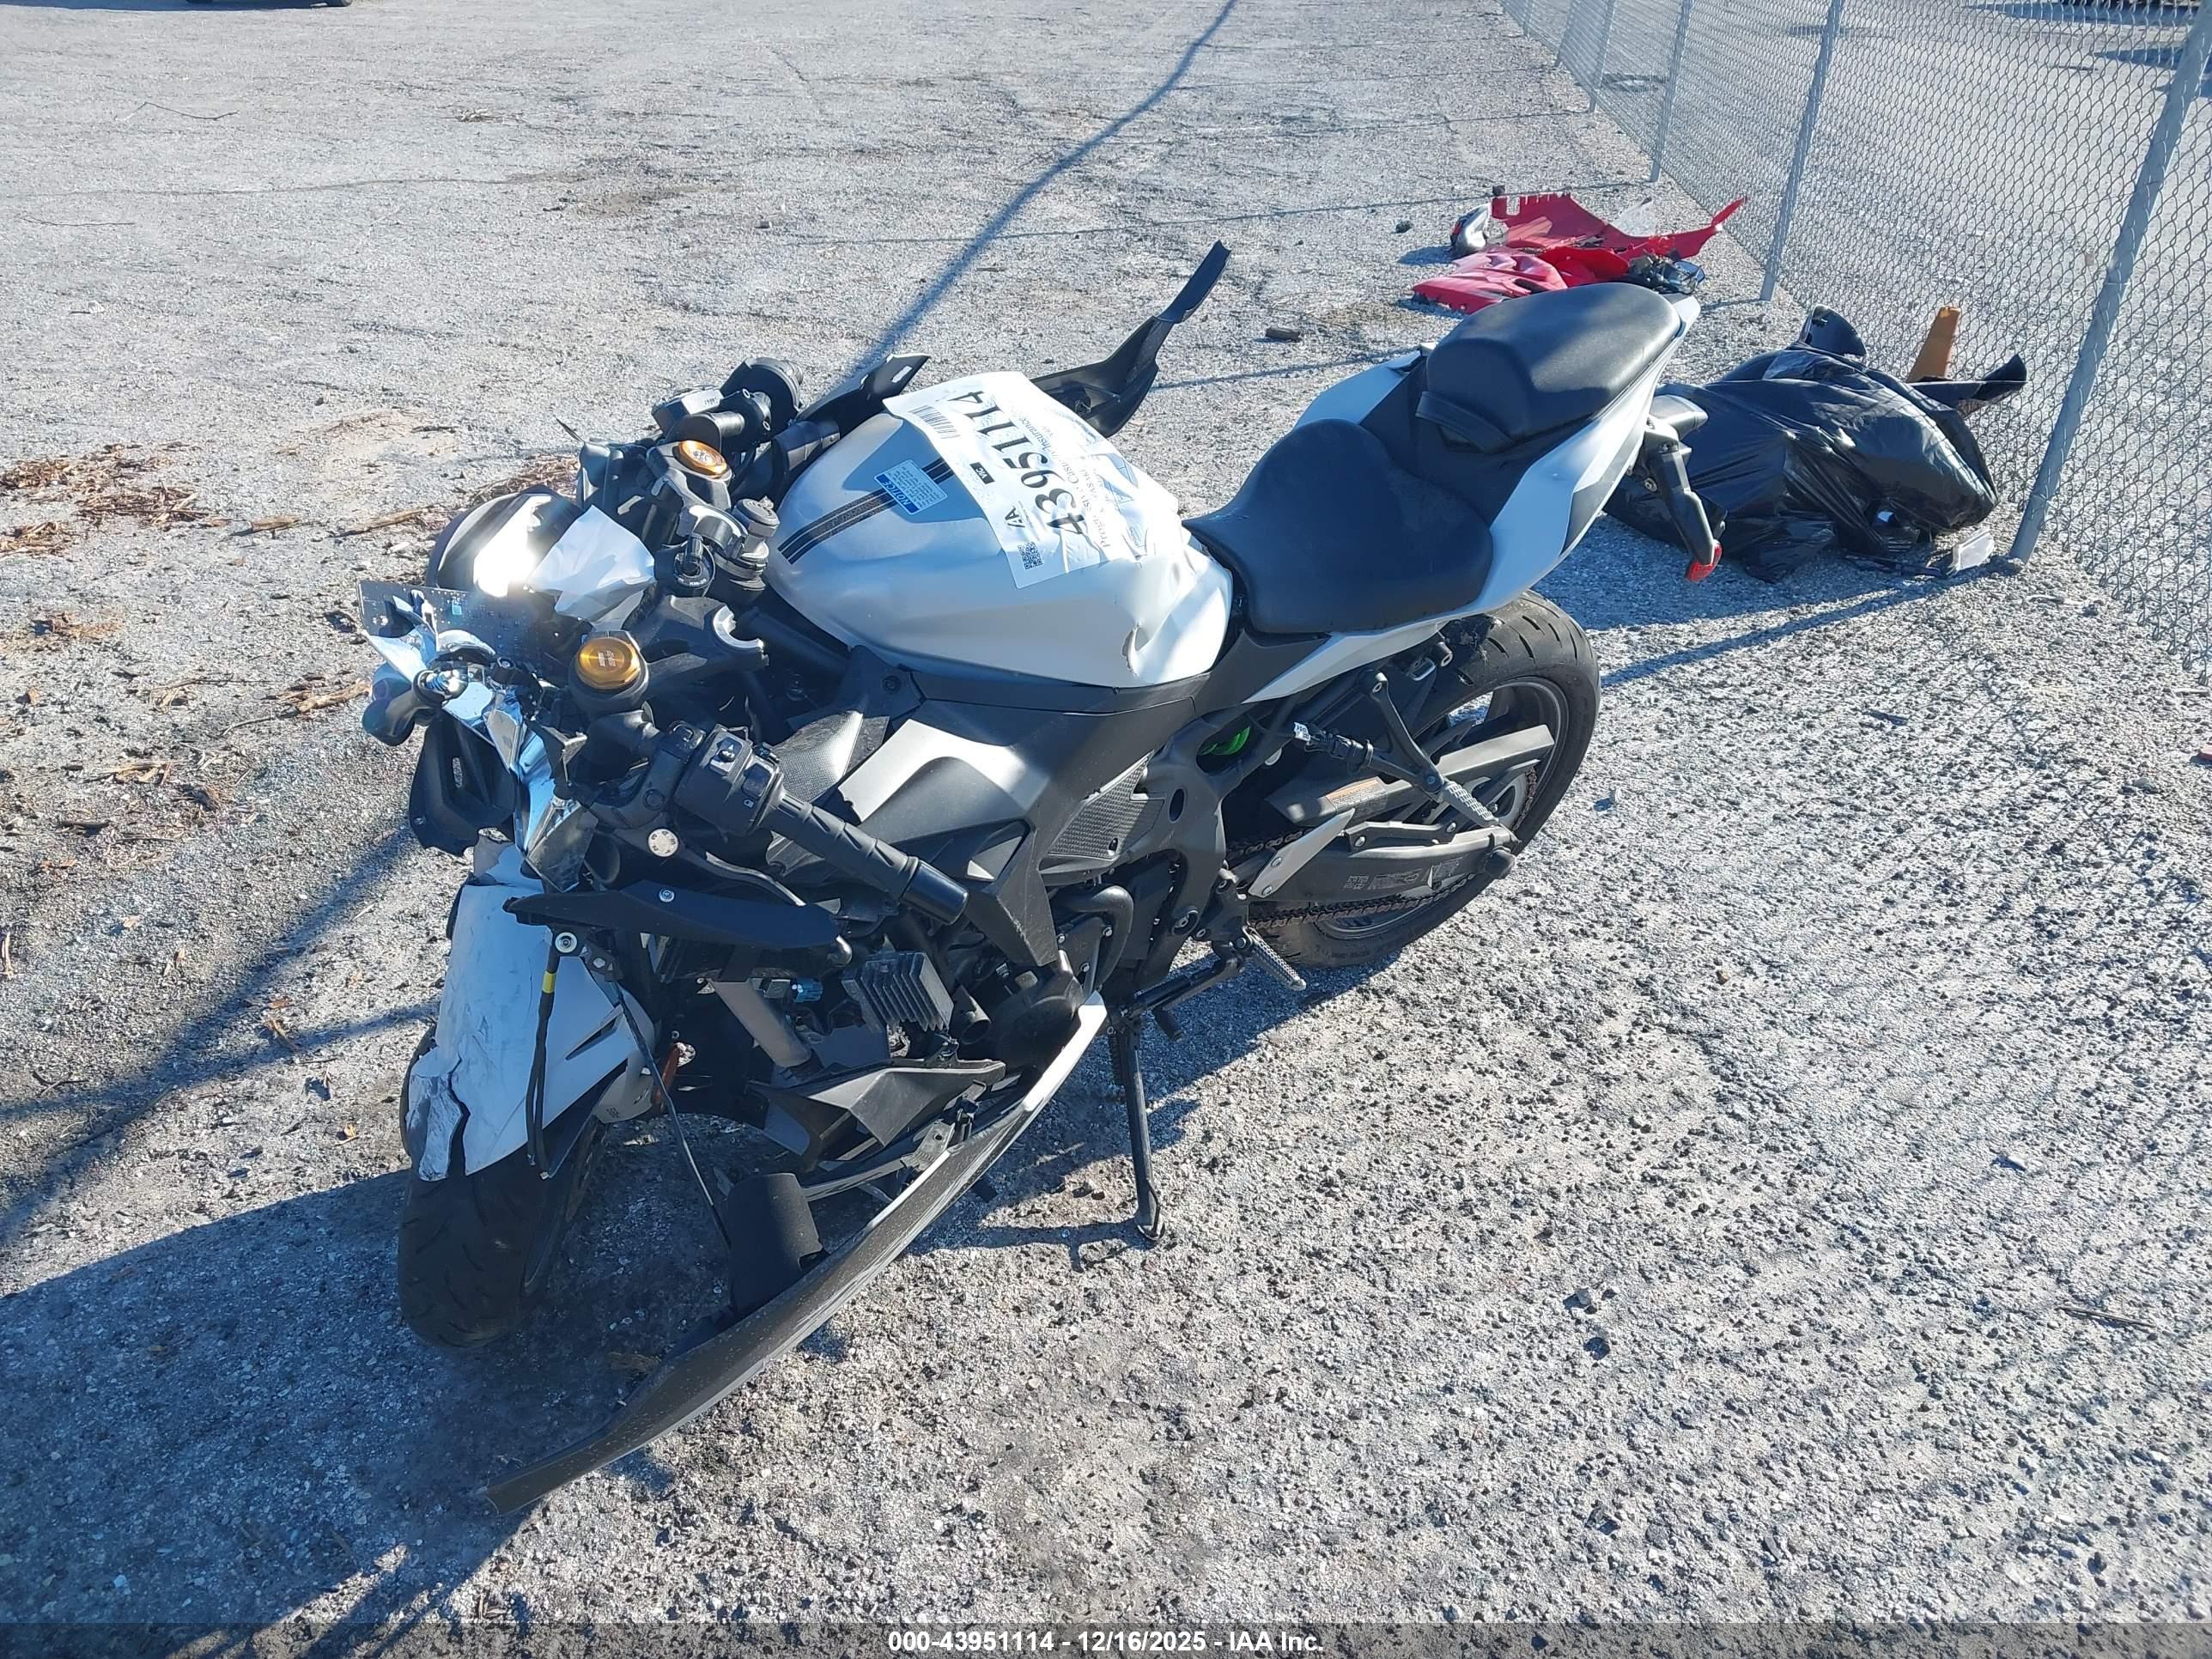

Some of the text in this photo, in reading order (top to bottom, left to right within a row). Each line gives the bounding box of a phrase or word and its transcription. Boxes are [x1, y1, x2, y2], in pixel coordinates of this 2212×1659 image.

[1019, 417, 1051, 451] Insurance
[948, 391, 1085, 534] 43951114
[882, 480, 911, 506] NOTICE
